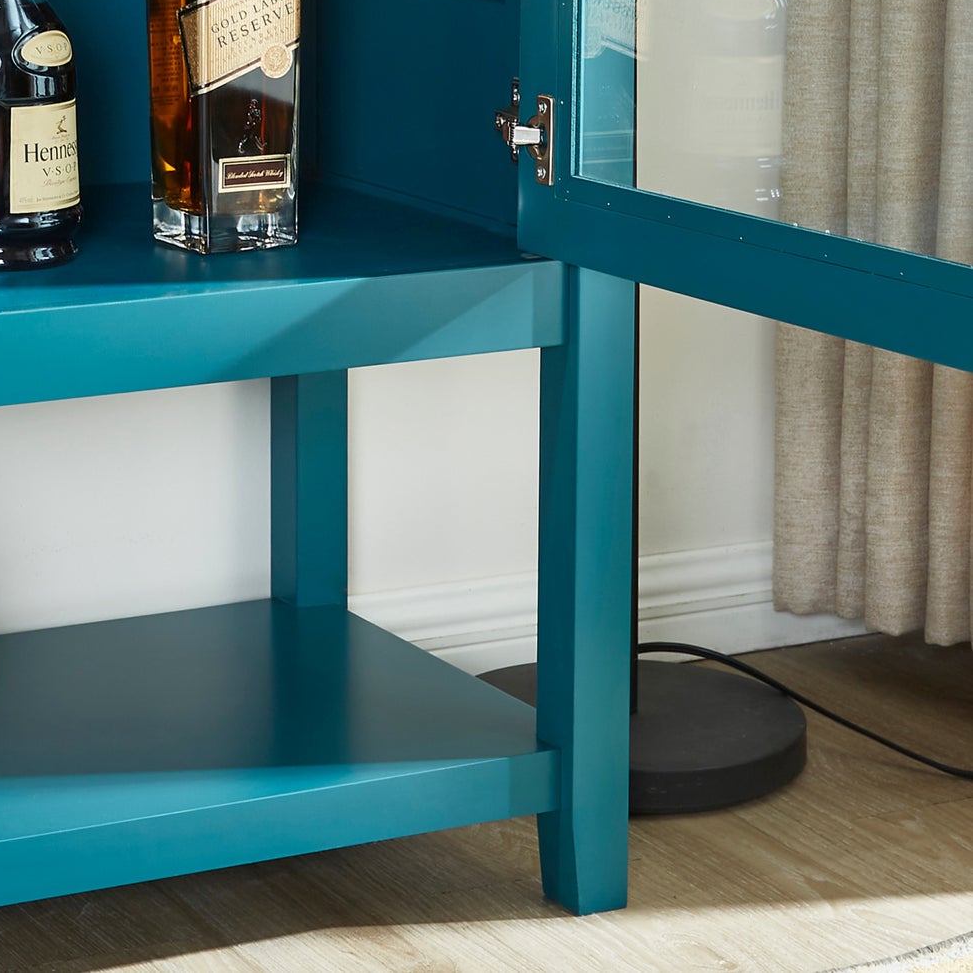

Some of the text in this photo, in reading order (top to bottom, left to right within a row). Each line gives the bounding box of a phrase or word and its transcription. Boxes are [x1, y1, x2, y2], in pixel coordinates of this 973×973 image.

[211, 10, 248, 34] GOLD
[217, 2, 295, 48] RESERVE
[24, 140, 77, 163] Hennes
